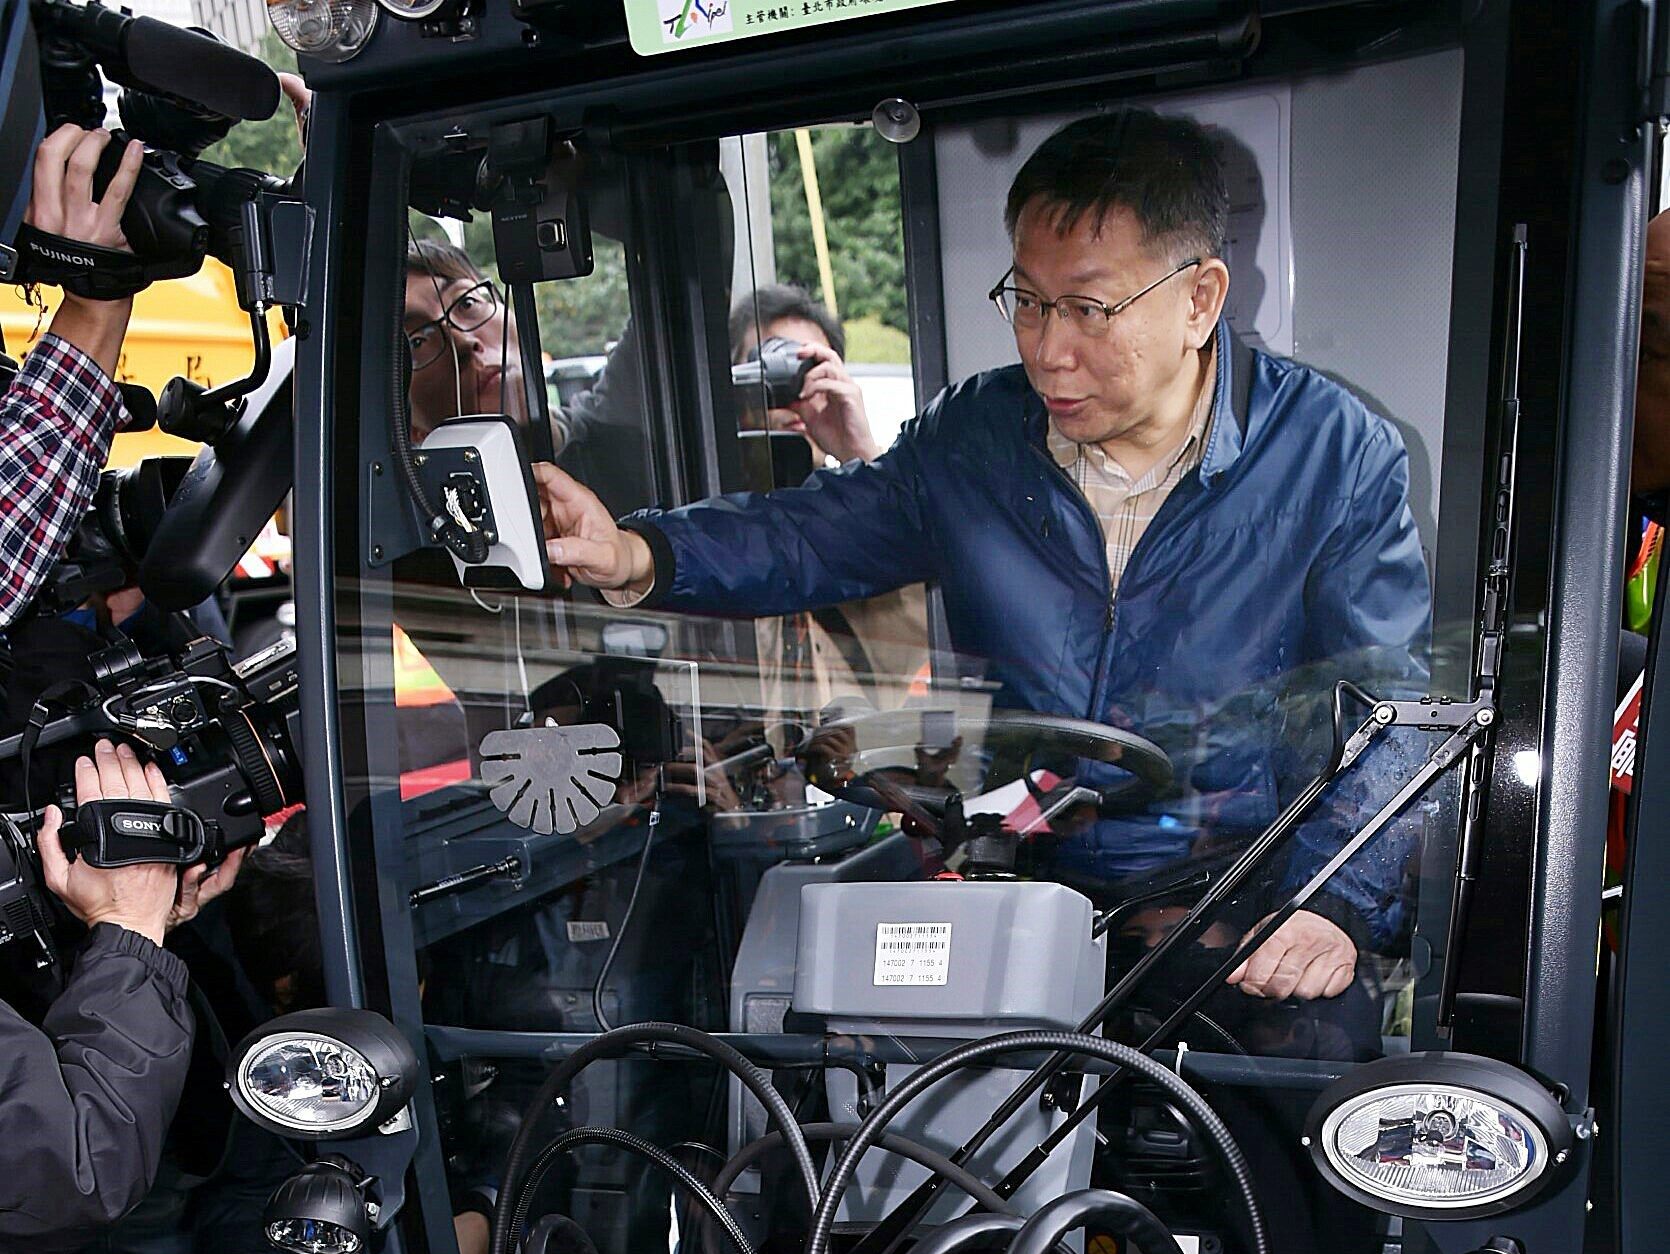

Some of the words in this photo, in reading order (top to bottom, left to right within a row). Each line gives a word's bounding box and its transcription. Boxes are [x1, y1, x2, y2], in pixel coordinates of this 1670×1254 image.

[29, 242, 95, 267] FUJINON
[122, 819, 162, 832] SONY
[881, 974, 905, 983] 147002
